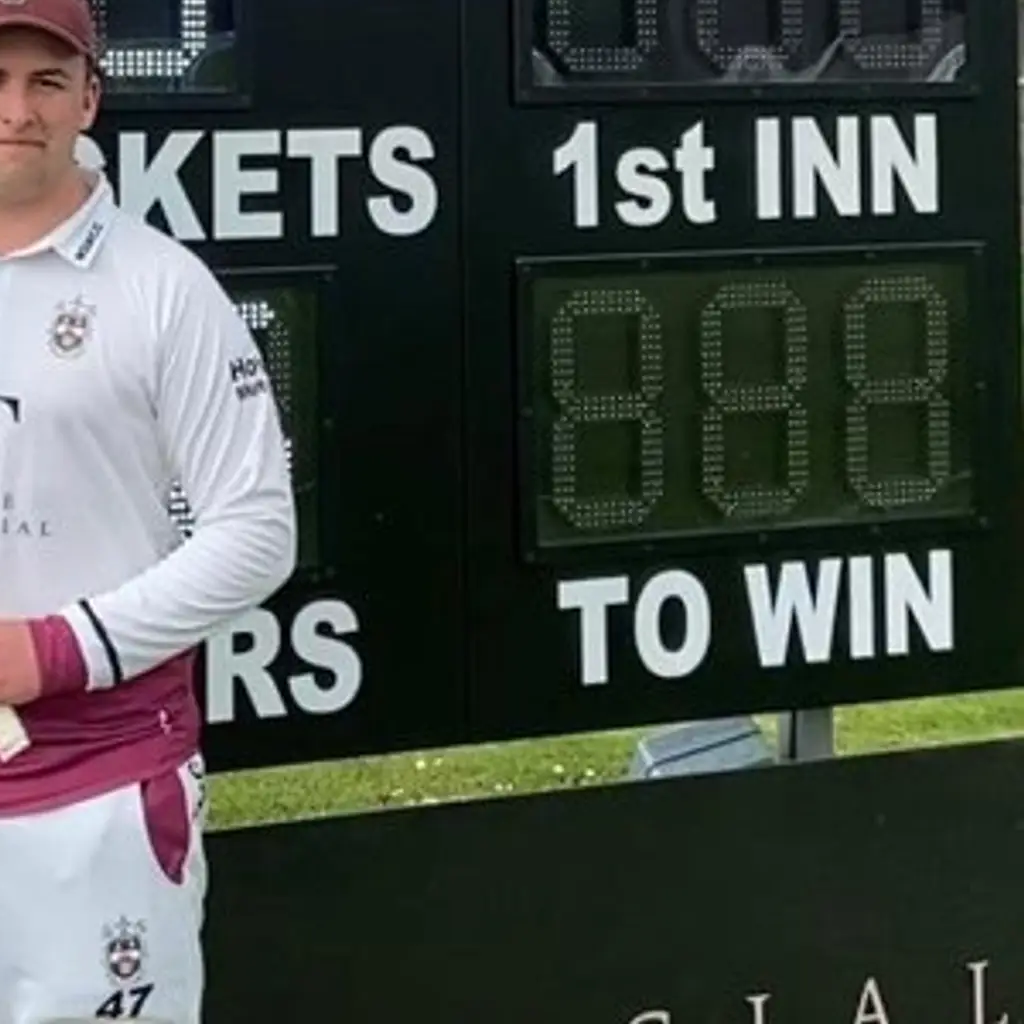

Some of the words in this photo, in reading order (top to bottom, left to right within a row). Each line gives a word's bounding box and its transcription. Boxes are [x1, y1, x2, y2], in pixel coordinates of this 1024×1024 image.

[552, 120, 717, 228] 1st
[754, 113, 940, 219] INN
[556, 569, 712, 687] TO
[743, 548, 955, 668] WIN
[94, 982, 155, 1019] 47
